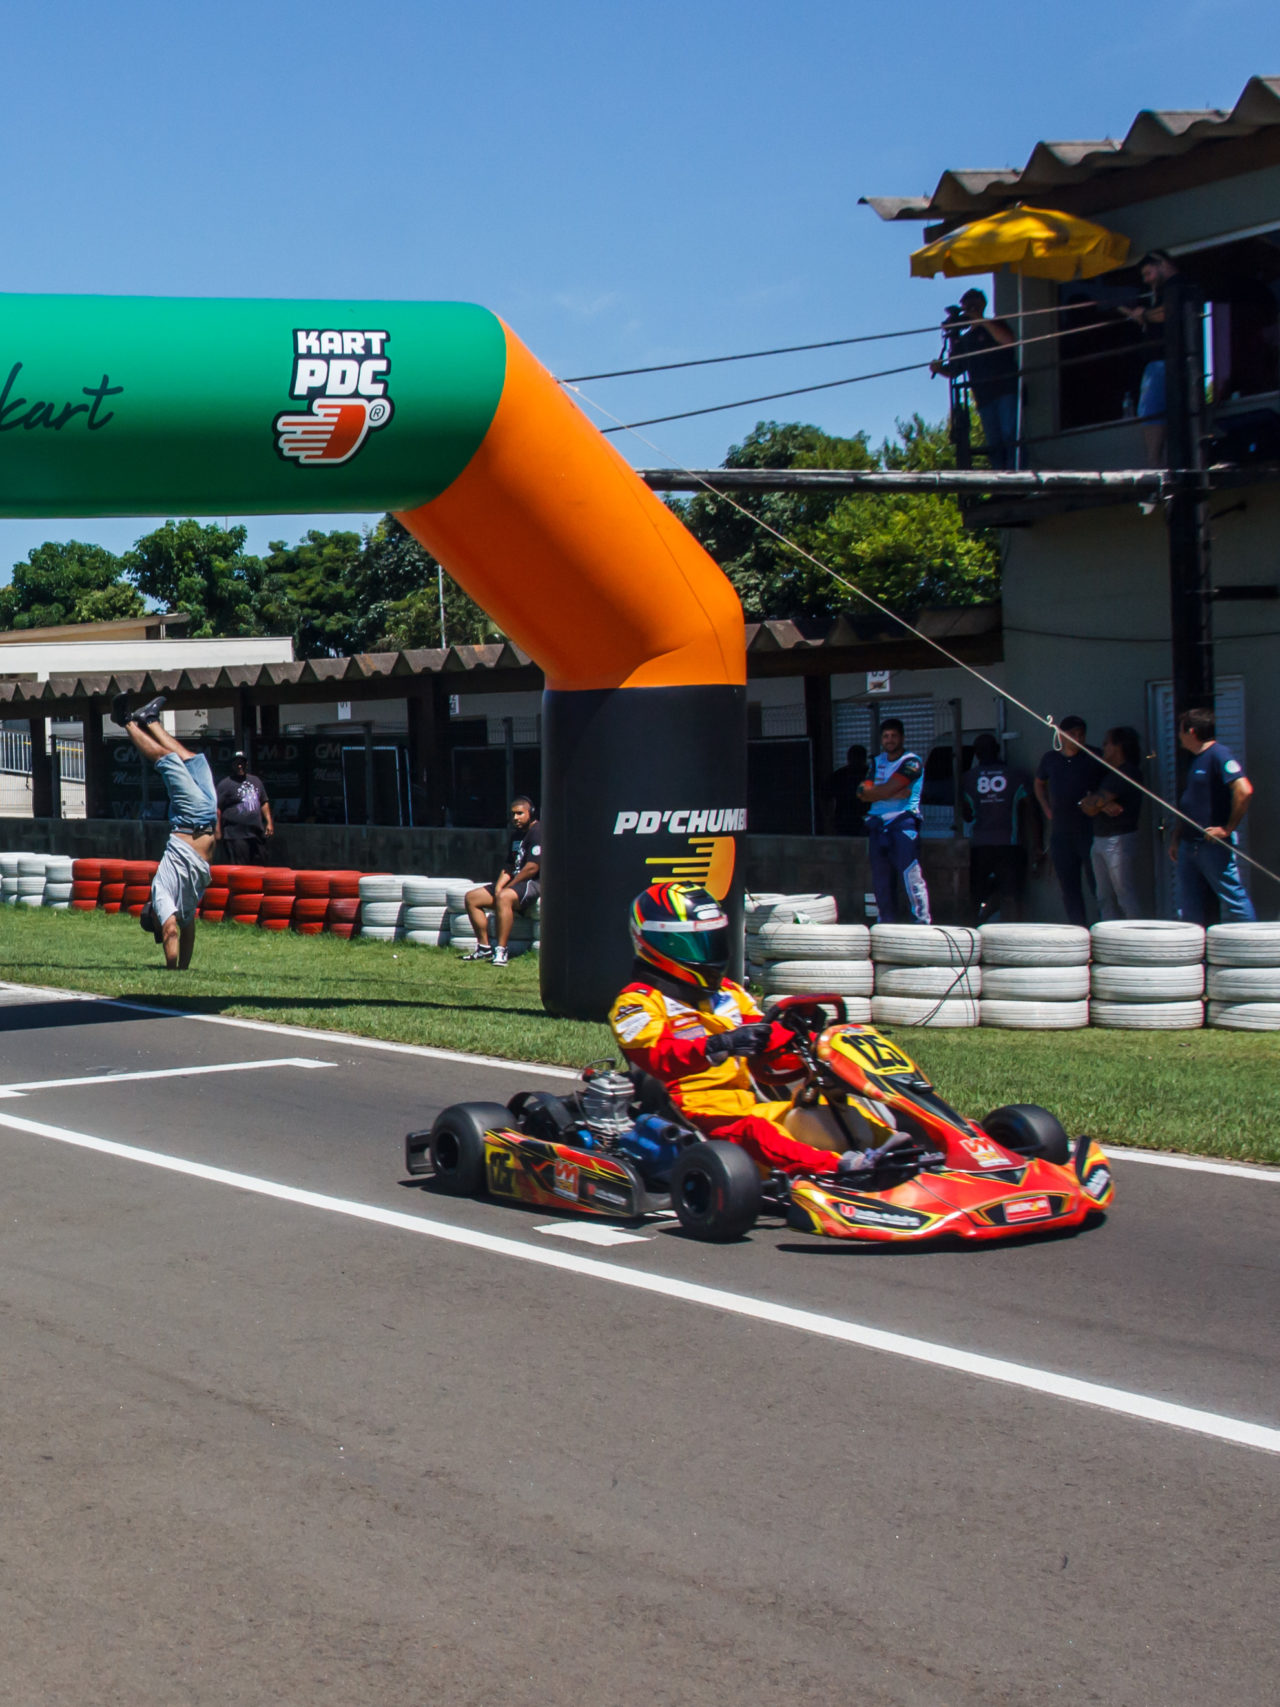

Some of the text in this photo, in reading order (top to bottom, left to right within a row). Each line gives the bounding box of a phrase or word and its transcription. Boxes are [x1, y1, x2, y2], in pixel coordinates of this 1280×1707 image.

[296, 331, 387, 356] KART
[294, 359, 388, 397] PDC
[977, 775, 1008, 794] 80
[841, 1034, 910, 1070] 125
